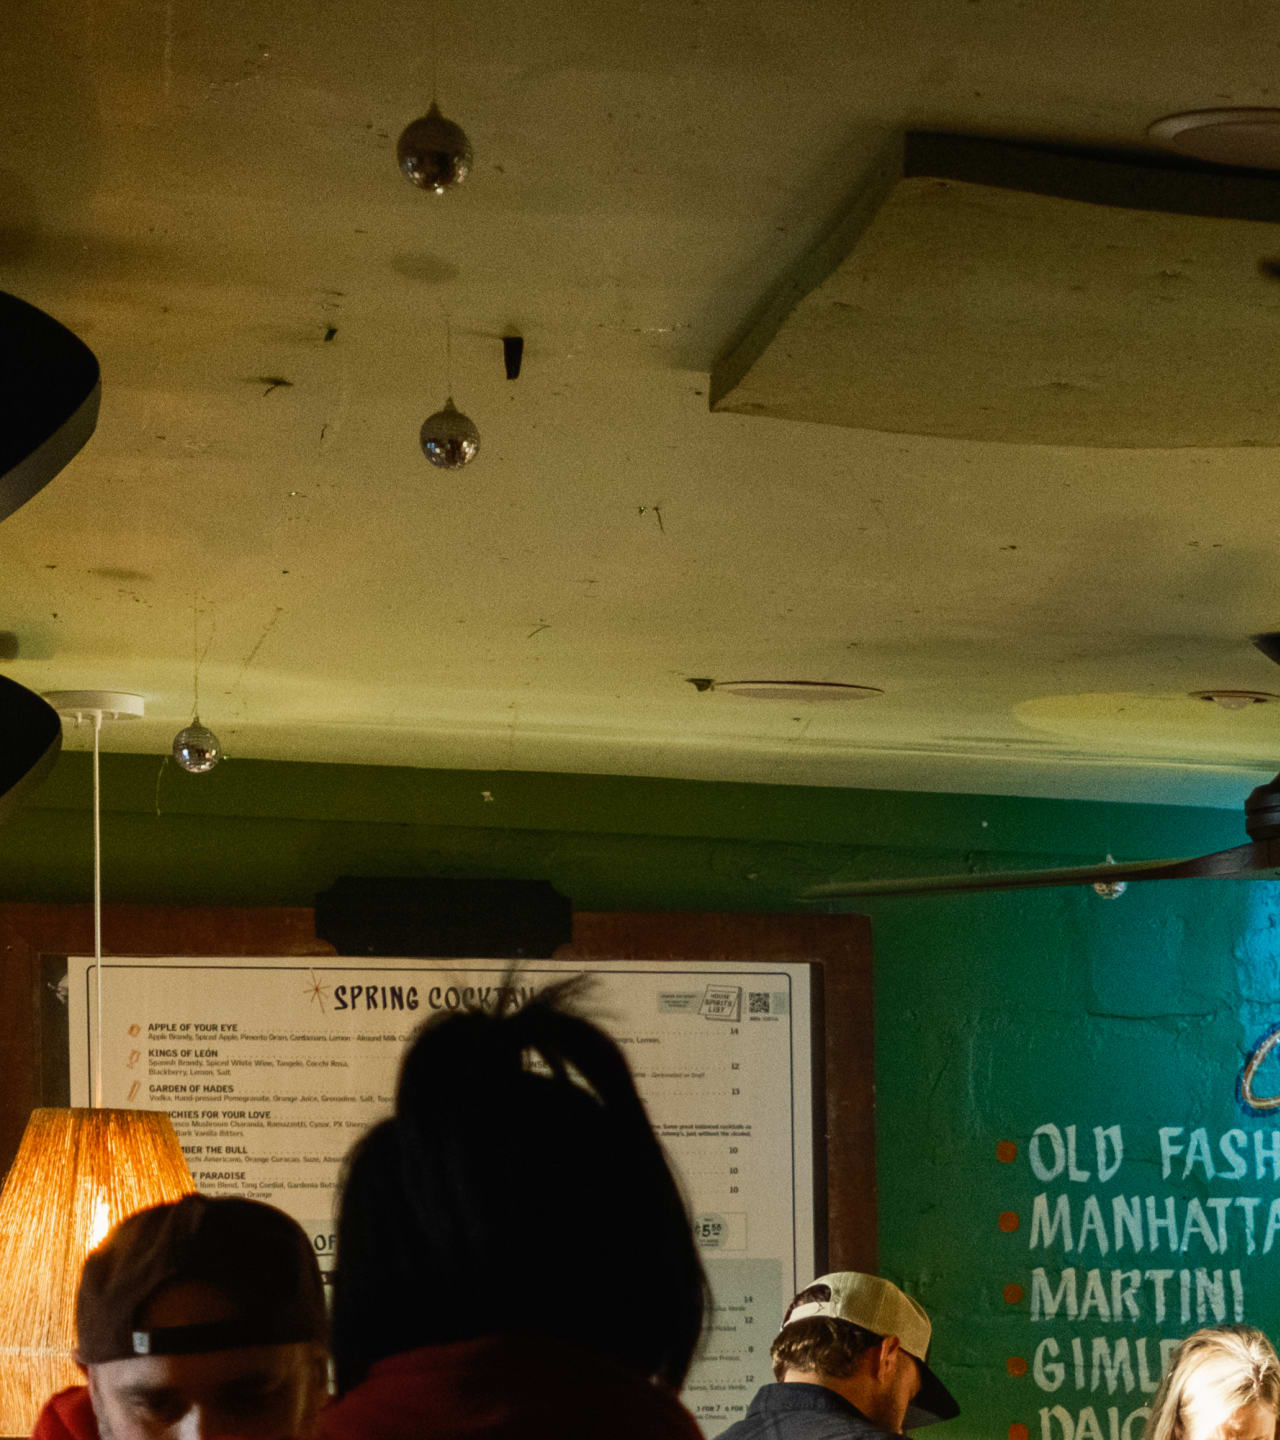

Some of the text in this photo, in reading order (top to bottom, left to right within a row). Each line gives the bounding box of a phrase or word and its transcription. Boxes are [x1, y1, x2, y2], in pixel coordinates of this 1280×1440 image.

[333, 985, 419, 1011] SPRING
[148, 1023, 238, 1032] APPLE OF YOUR EYE
[148, 1049, 218, 1058] KINGS OF LEÓN
[149, 1085, 234, 1093] GARDEN OF HADES
[202, 1111, 219, 1119] FOR
[222, 1111, 246, 1119] YOUR
[248, 1111, 271, 1119] LOVE
[206, 1146, 222, 1154] THE
[225, 1146, 248, 1154] BULL
[1029, 1122, 1124, 1183] OLD
[200, 1172, 246, 1180] PARADISE
[730, 1186, 739, 1194] 10
[1029, 1267, 1244, 1324] MARTINI
